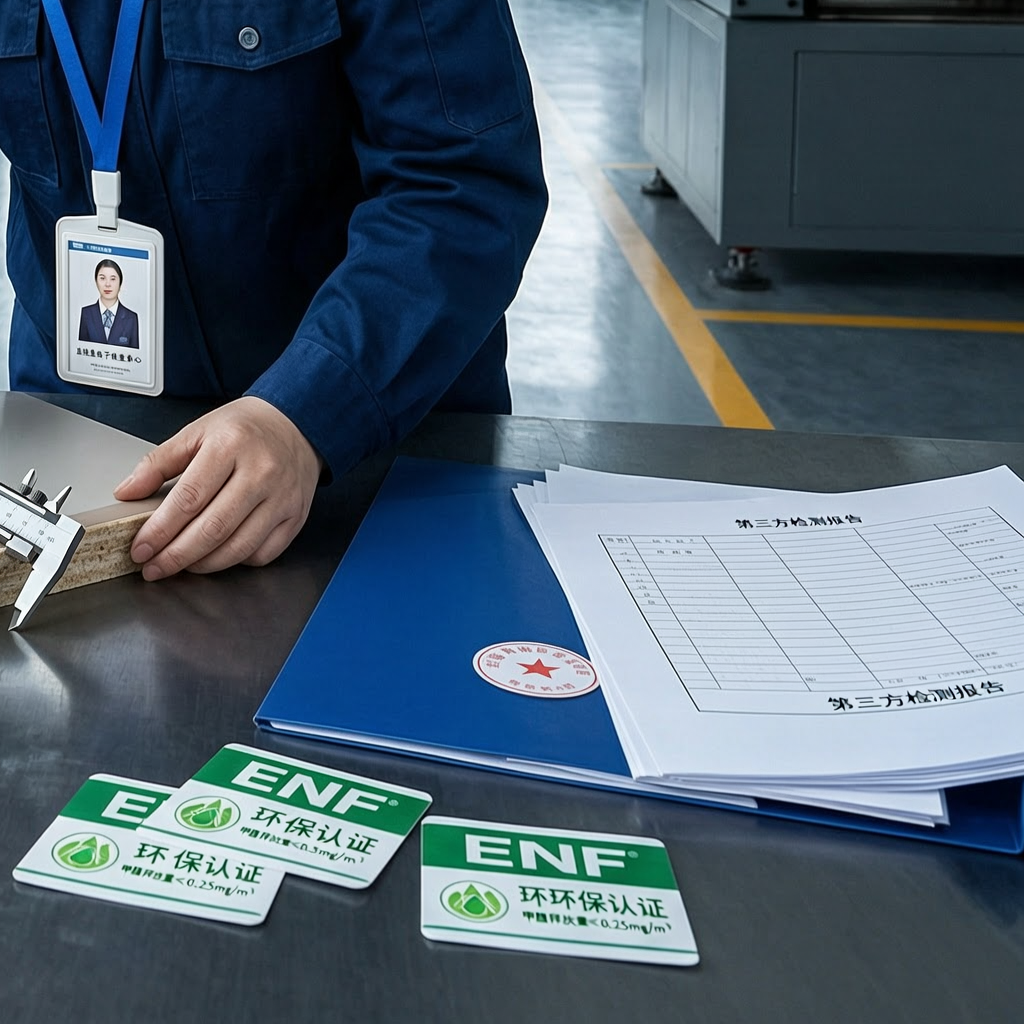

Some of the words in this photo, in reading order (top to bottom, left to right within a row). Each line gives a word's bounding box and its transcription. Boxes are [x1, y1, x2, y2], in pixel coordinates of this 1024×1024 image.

[230, 760, 389, 815] ENF
[250, 806, 379, 856] 环保认证
[133, 842, 265, 884] 环保认证
[464, 833, 626, 878] ENF
[518, 885, 669, 919] 环环保认证
